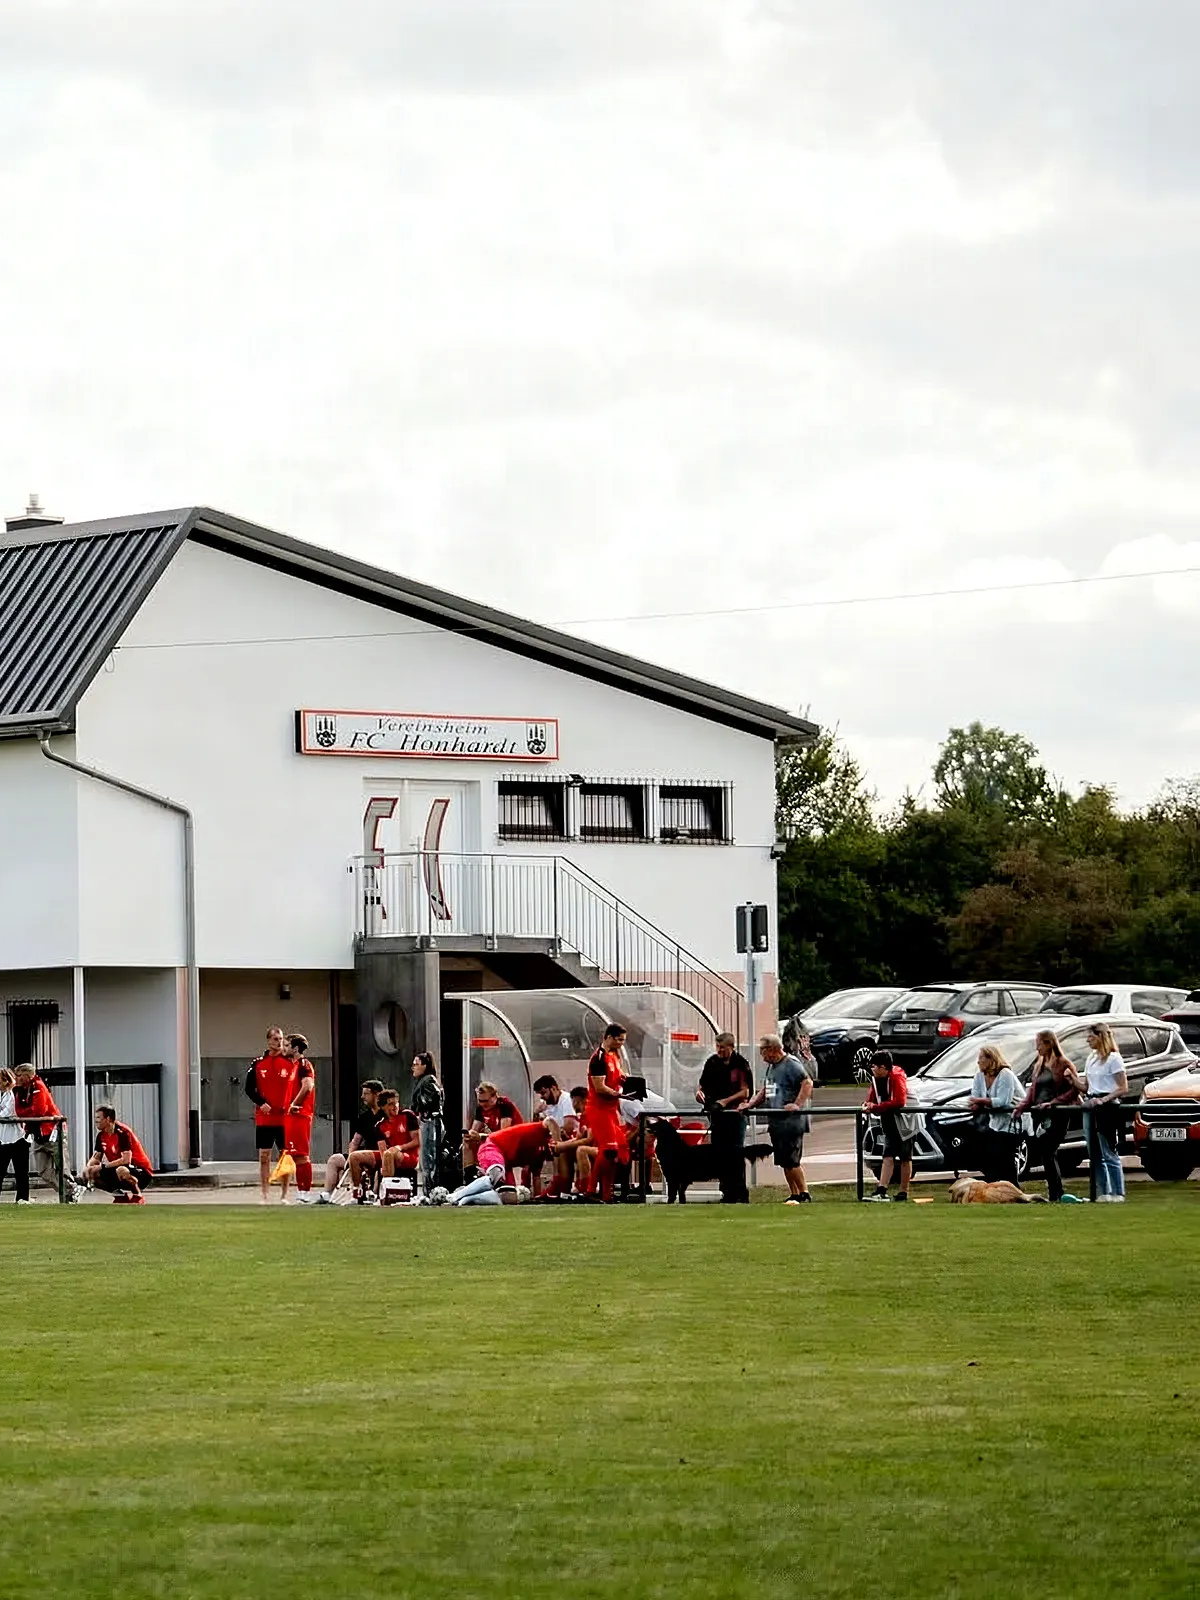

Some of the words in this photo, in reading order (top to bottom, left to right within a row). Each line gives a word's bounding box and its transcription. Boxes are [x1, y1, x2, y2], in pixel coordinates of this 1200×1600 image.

[376, 717, 489, 735] Vereinsheim
[350, 731, 386, 749] FC
[399, 733, 519, 754] Honhardt
